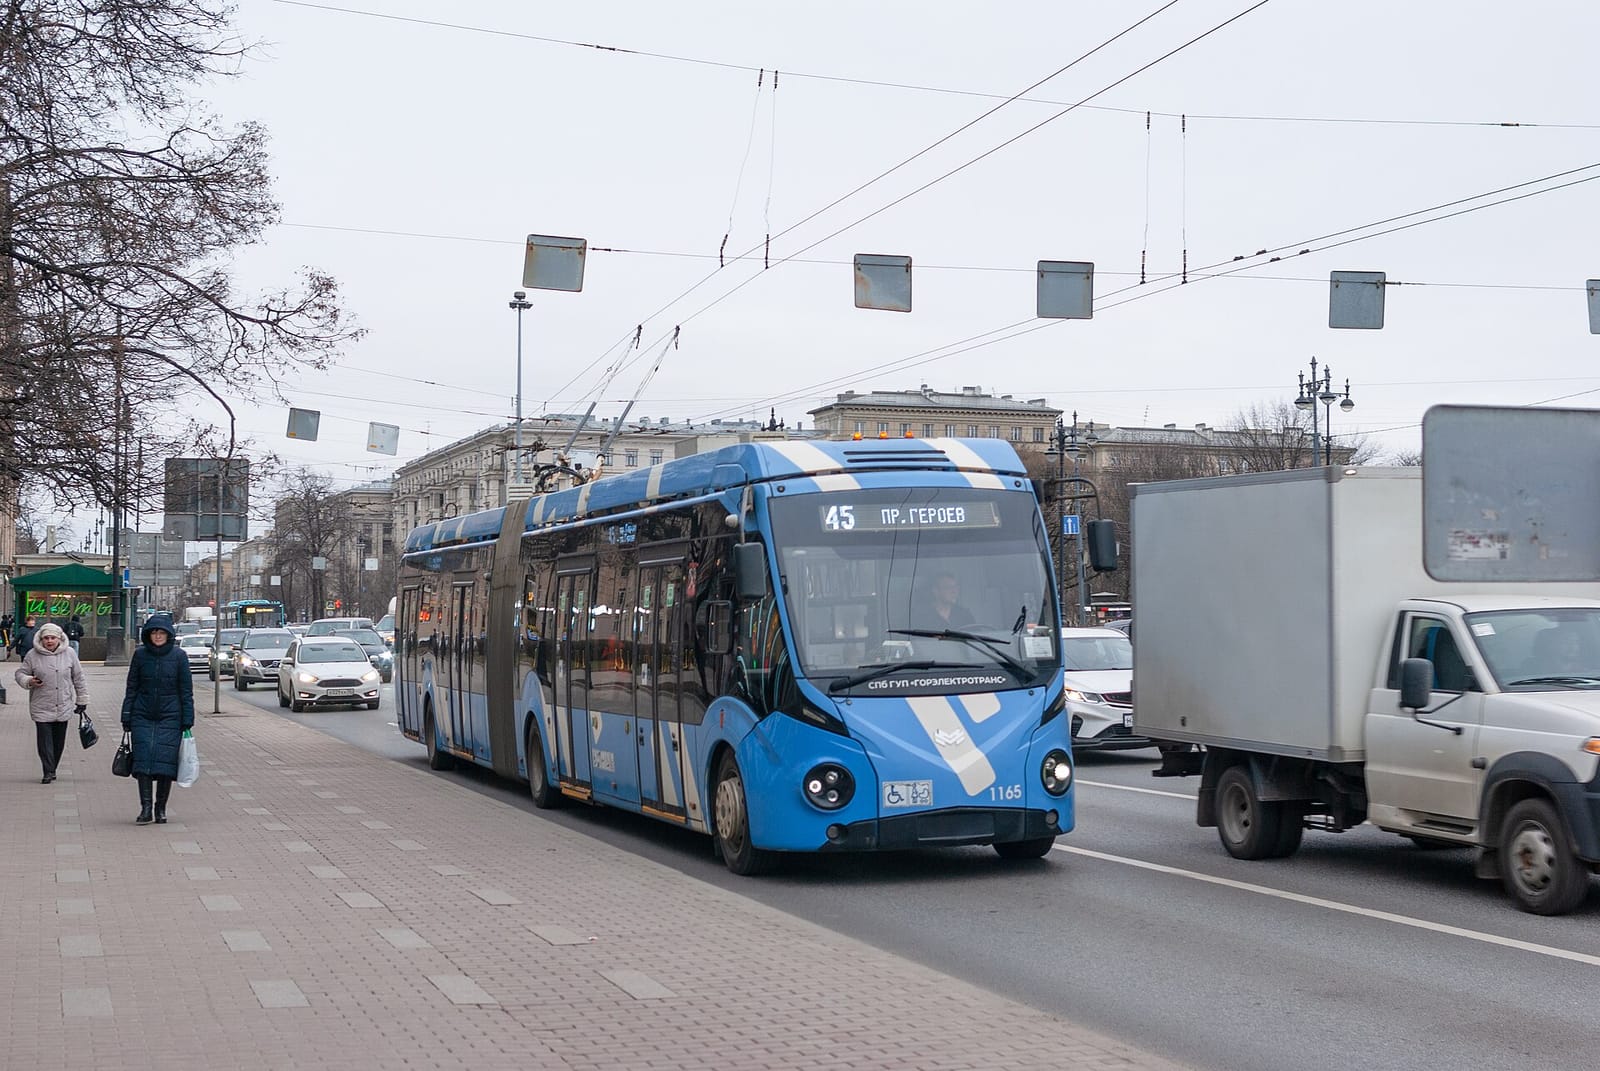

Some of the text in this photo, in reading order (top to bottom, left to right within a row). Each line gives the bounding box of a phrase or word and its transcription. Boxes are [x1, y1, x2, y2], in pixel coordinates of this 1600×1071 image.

[825, 505, 855, 530] 45
[889, 679, 909, 689] ГУП
[990, 784, 1022, 801] 1165
